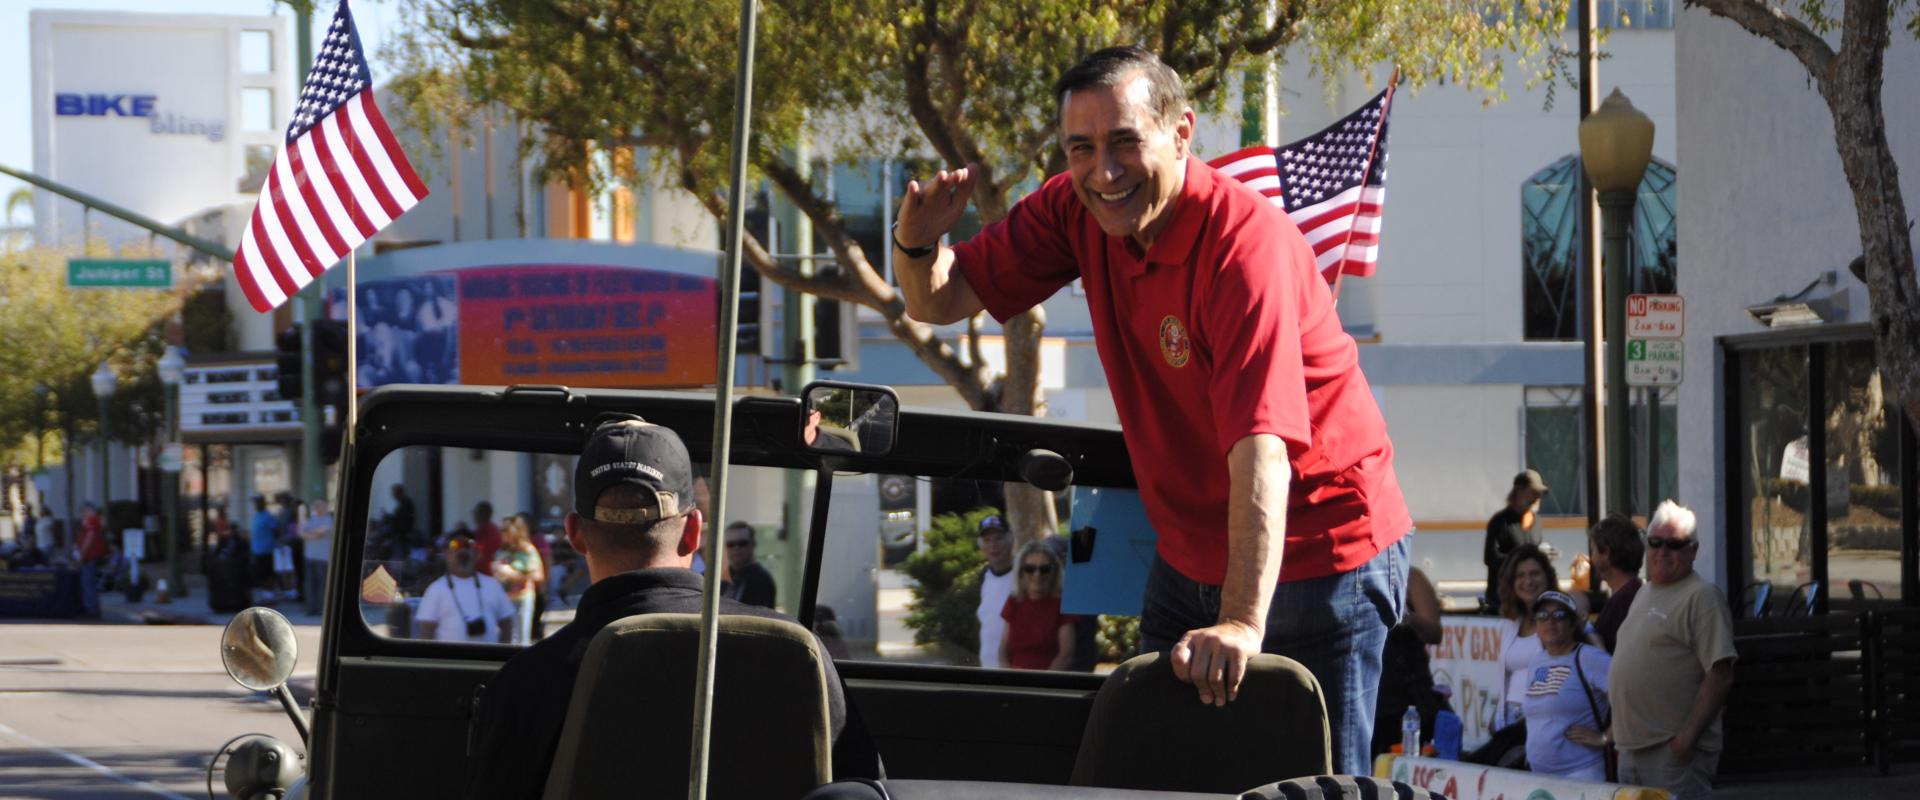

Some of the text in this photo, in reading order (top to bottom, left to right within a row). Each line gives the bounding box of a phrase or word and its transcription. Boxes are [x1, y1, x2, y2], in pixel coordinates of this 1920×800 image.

[55, 93, 157, 117] BIKE
[149, 109, 226, 142] bling
[75, 266, 165, 283] Juniper St
[1629, 297, 1681, 315] NO PARKING
[1631, 341, 1676, 359] 3 HOUR
[1648, 350, 1680, 362] PARKING
[590, 463, 612, 477] UNITED
[612, 461, 637, 470] STATES
